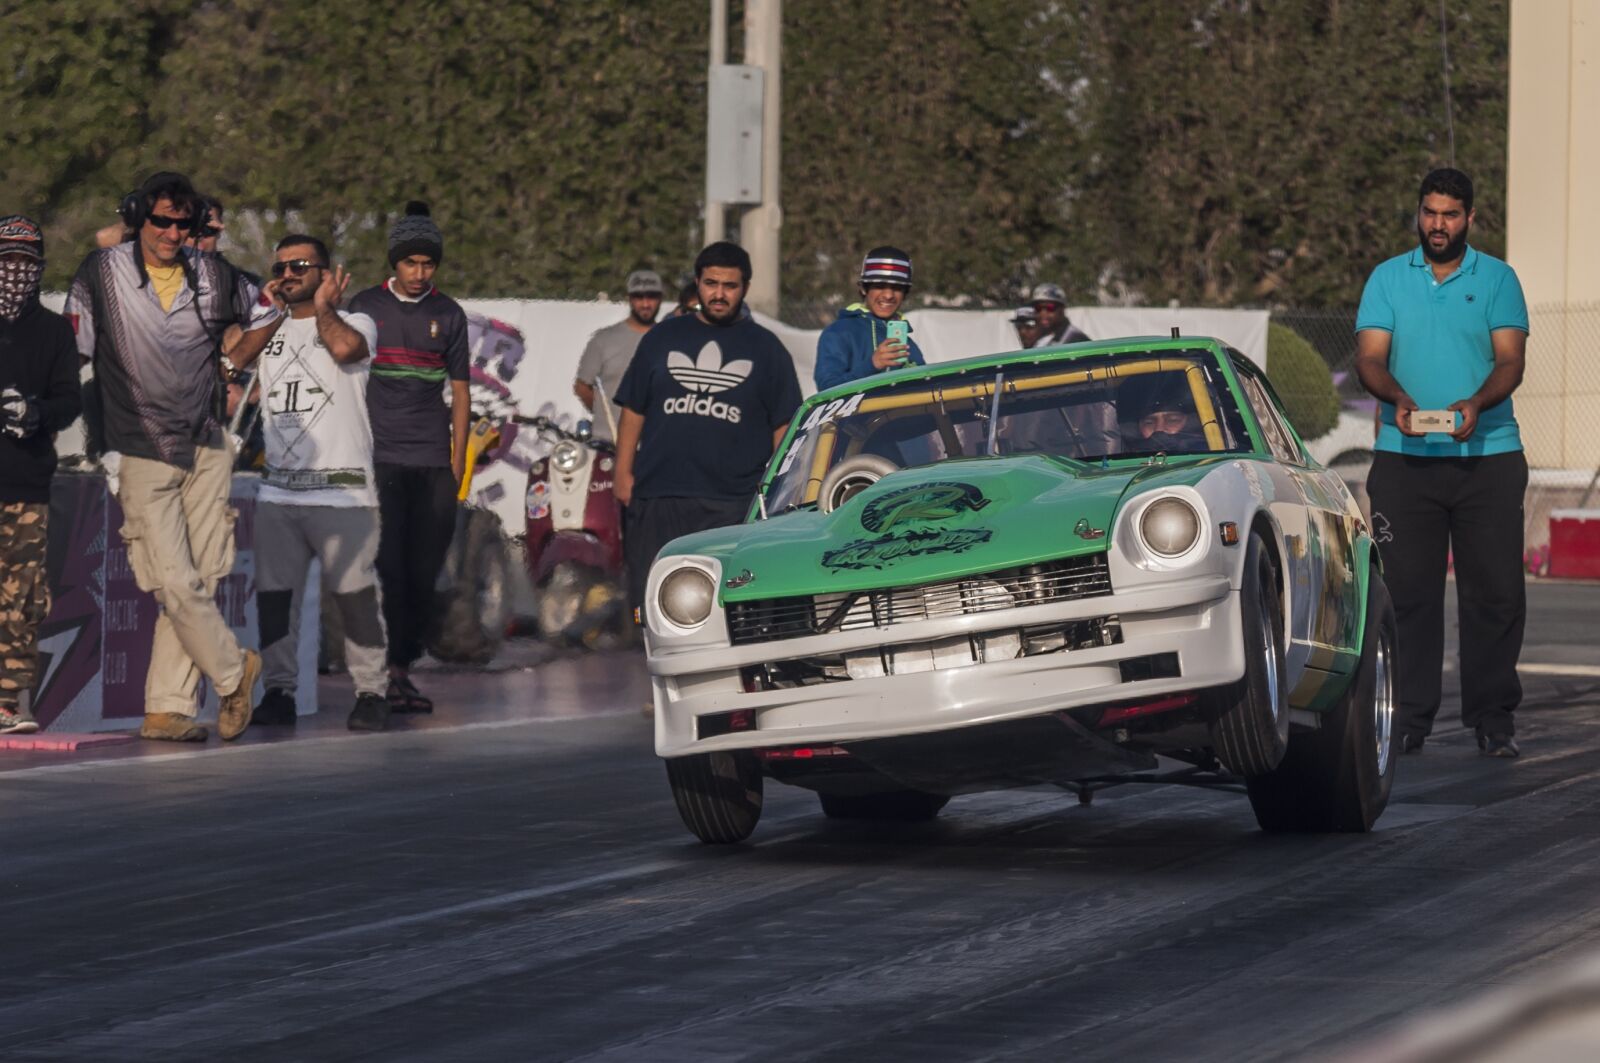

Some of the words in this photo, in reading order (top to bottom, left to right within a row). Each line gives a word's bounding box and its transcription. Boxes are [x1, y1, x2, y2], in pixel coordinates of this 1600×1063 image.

[663, 393, 742, 424] adidas
[800, 393, 865, 431] 424
[590, 481, 614, 492] Qata
[108, 548, 133, 580] QATA
[106, 599, 139, 631] RACING
[105, 651, 127, 684] CLUB
